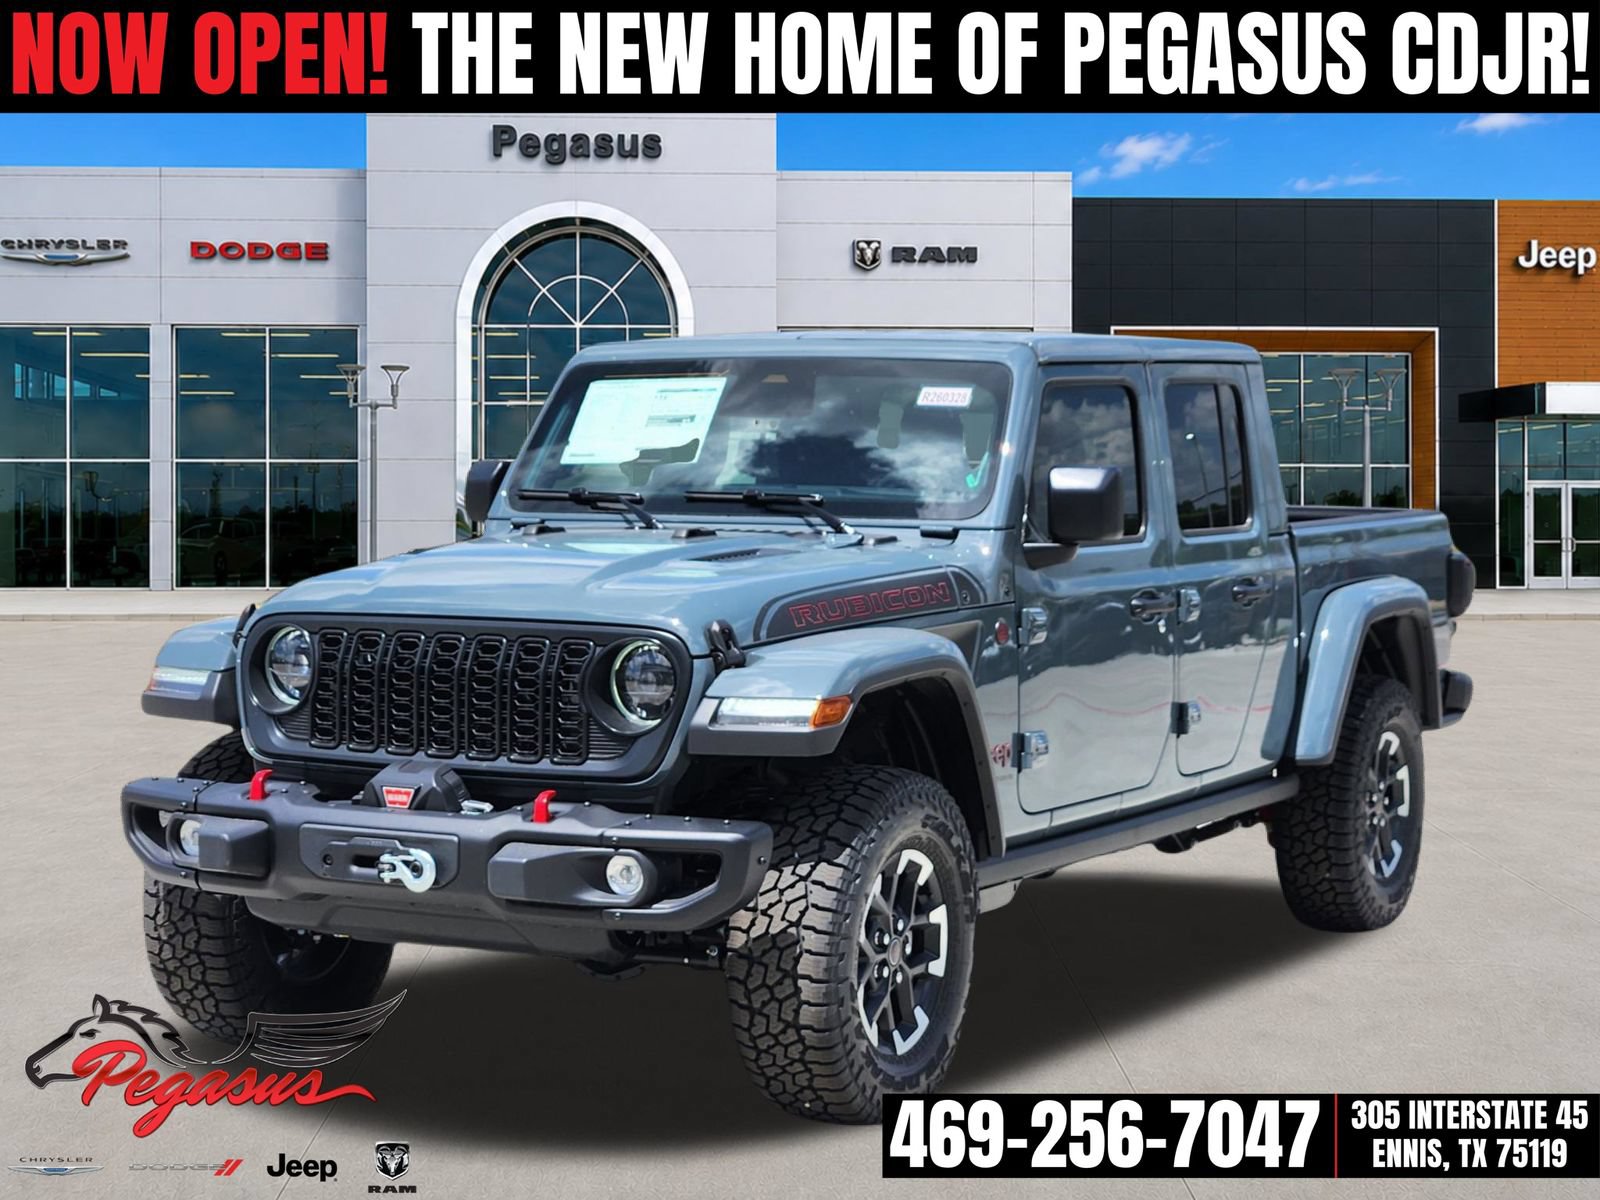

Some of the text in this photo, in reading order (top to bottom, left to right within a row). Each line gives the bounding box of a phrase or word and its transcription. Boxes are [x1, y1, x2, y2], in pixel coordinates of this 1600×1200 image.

[492, 124, 663, 165] Pegasus
[0, 239, 128, 250] CHRYSLER
[190, 241, 329, 260] DODGE
[891, 246, 978, 263] RAM
[1518, 239, 1597, 275] Jeep
[789, 582, 951, 628] RUBICON
